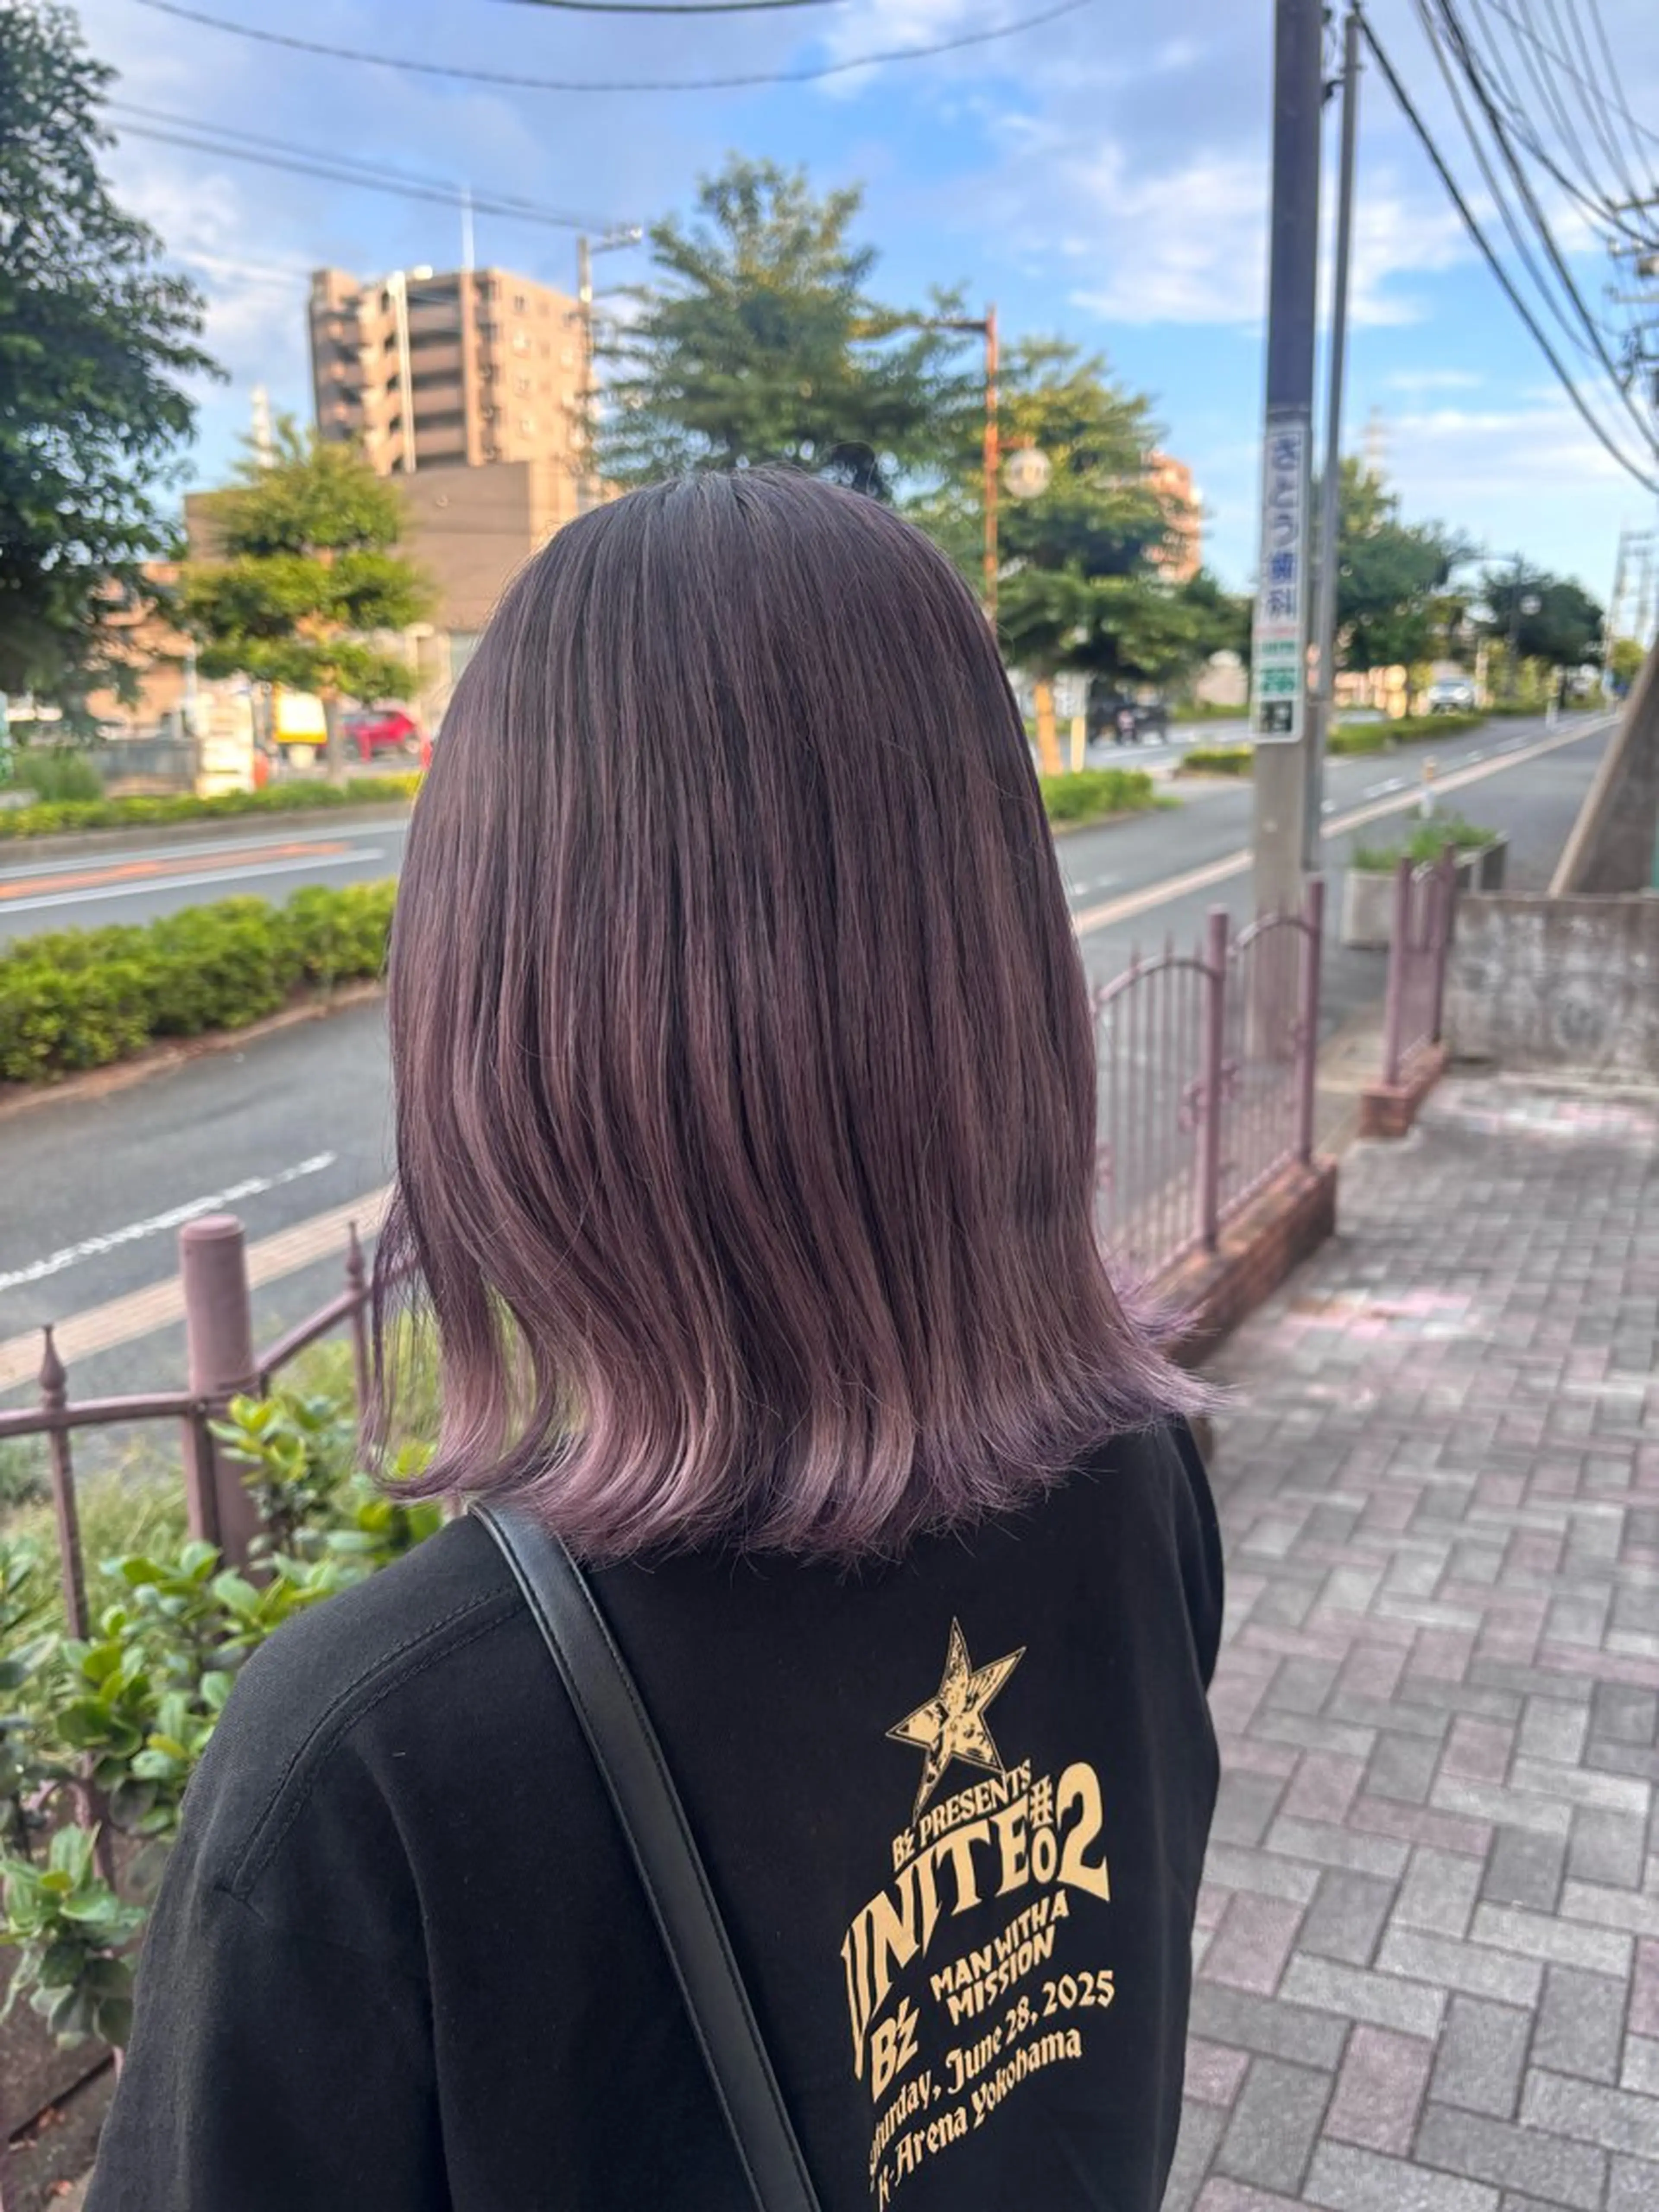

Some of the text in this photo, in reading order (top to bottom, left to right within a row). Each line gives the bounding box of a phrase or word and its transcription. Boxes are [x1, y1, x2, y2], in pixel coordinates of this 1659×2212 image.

[919, 1758, 1032, 1848] PRESENTS
[930, 1888, 1069, 2002] MAN WITH A
[946, 1924, 1056, 2025] MISSION
[870, 1996, 920, 2103] B'z
[945, 2024, 1002, 2095] June
[1005, 1995, 1038, 2045] 28,
[1042, 1969, 1115, 2016] 2025
[971, 2028, 1083, 2129] Yokohama
